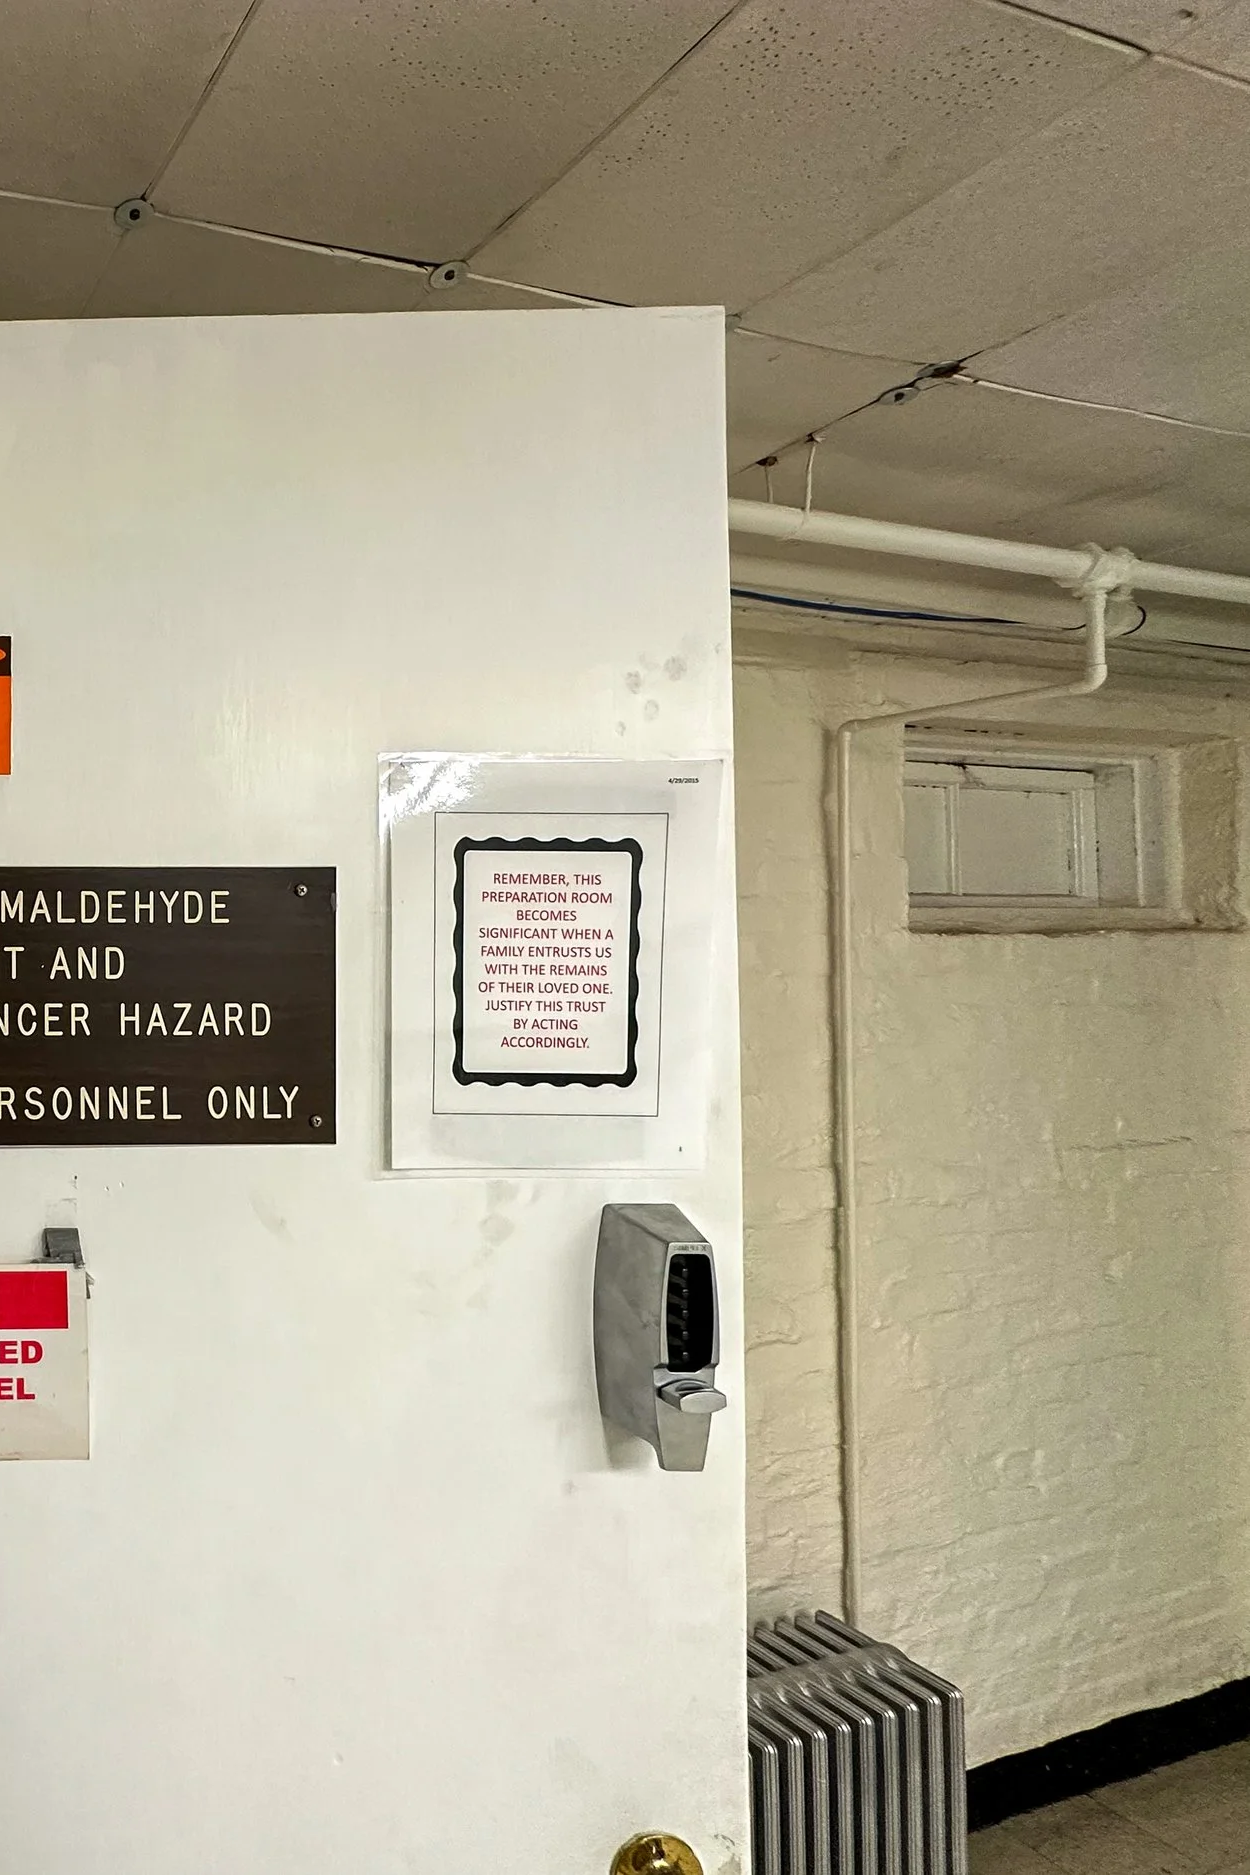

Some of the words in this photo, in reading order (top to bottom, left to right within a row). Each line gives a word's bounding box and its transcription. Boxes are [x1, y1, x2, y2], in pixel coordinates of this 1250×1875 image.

[493, 873, 570, 886] REMEMBER,
[574, 874, 602, 886] THIS
[481, 892, 567, 904] PREPARATION
[571, 892, 613, 904] ROOM
[516, 910, 577, 922] BECOMES
[478, 928, 557, 940] SIGNIFICANT
[561, 928, 601, 940] WHEN
[605, 929, 614, 940] A
[480, 946, 525, 957] FAMILY
[528, 946, 592, 958] ENTRUSTS
[595, 947, 612, 958] US
[49, 945, 126, 980] AND
[484, 964, 518, 975] WITH
[522, 964, 546, 976] THE
[549, 964, 607, 976] REMAINS
[478, 982, 495, 993] OF
[499, 982, 534, 994] THEIR
[538, 982, 579, 994] LOVED
[582, 983, 613, 995] ONE.
[485, 1000, 532, 1012] JUSTIFY
[536, 1000, 563, 1012] THIS
[567, 1001, 606, 1013] TRUST
[119, 1003, 272, 1037] HAZARD
[513, 1018, 528, 1030] BY
[531, 1019, 578, 1031] ACTING
[500, 1036, 590, 1049] ACCORDINGLY.
[207, 1086, 301, 1120] ONLY
